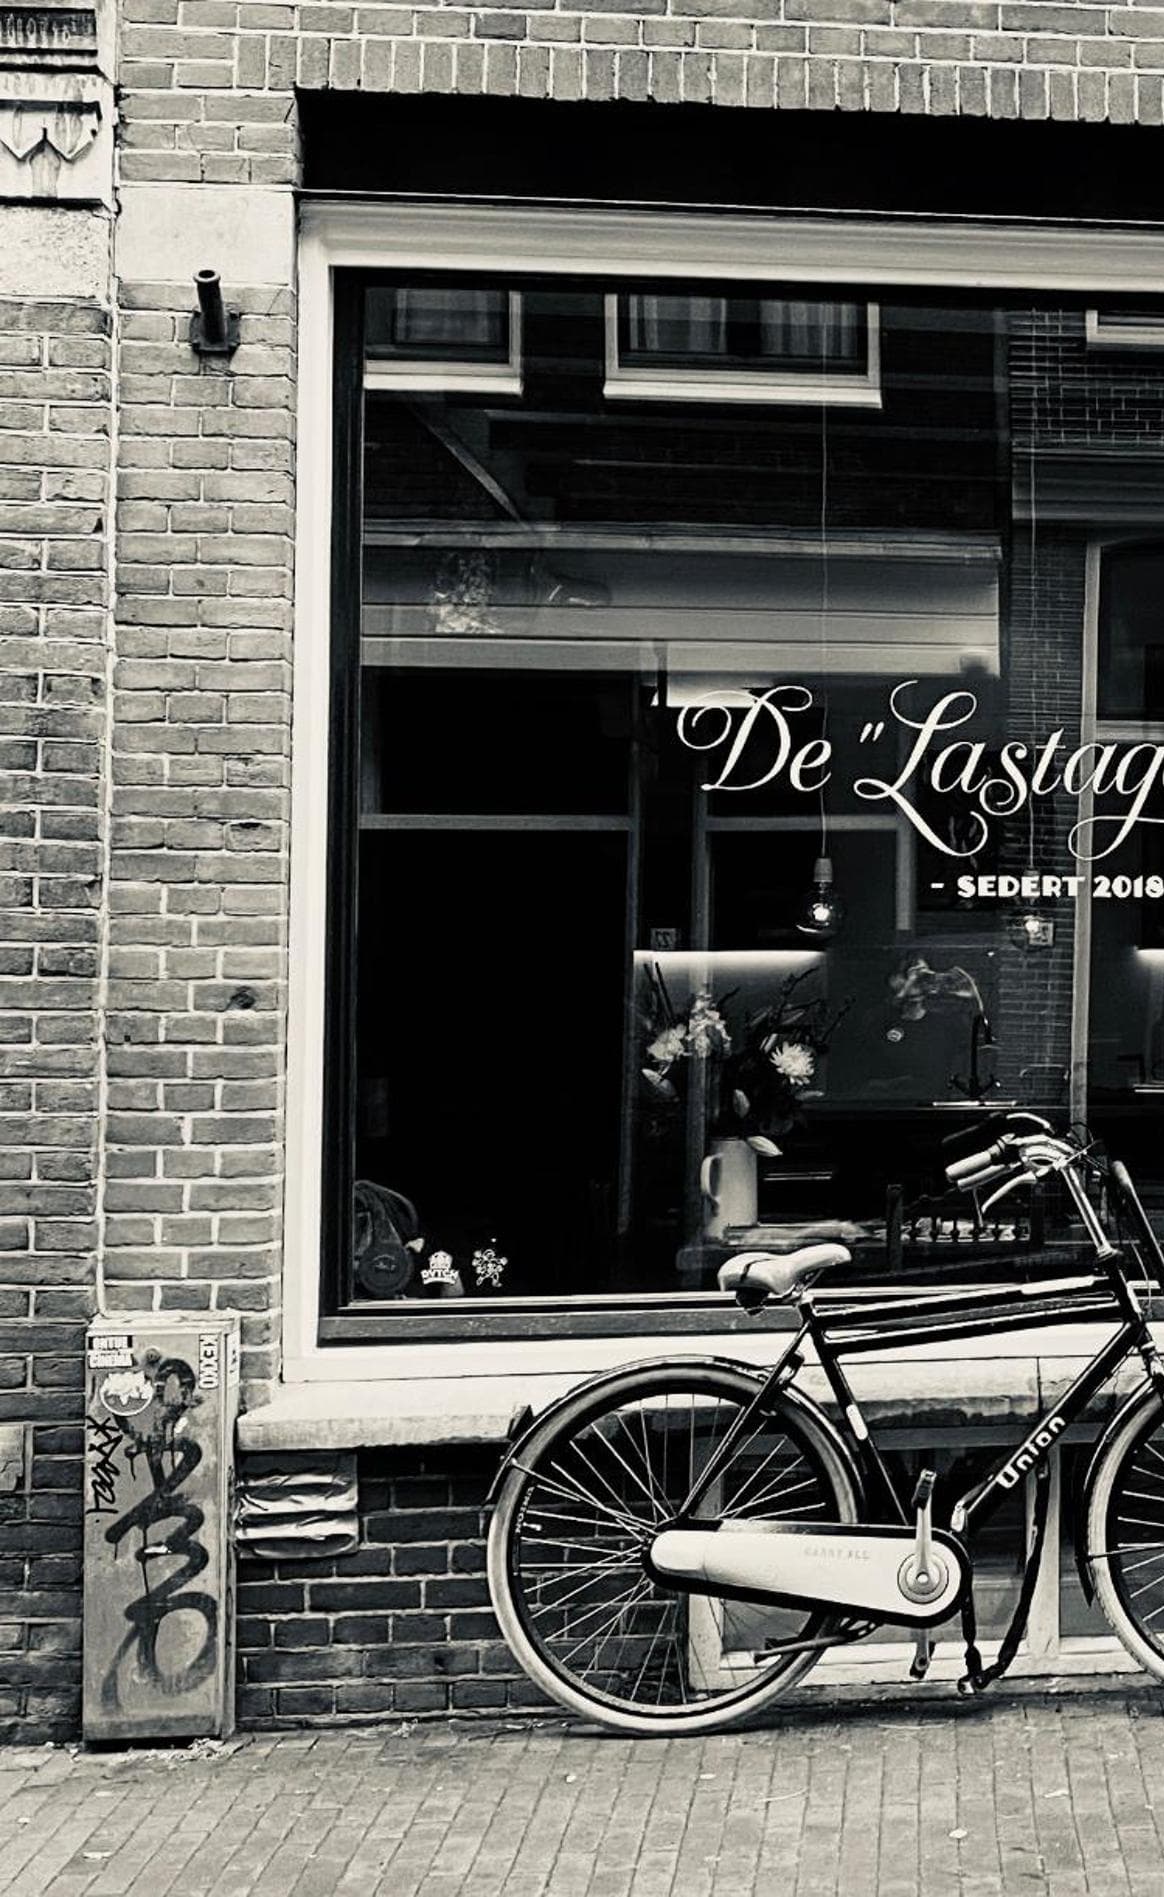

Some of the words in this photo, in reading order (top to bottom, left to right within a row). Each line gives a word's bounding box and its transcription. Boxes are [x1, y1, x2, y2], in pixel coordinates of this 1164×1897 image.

[677, 685, 832, 792] De
[957, 875, 1086, 898] SEDERT
[1092, 875, 1164, 898] 2018
[995, 1416, 1066, 1489] Union
